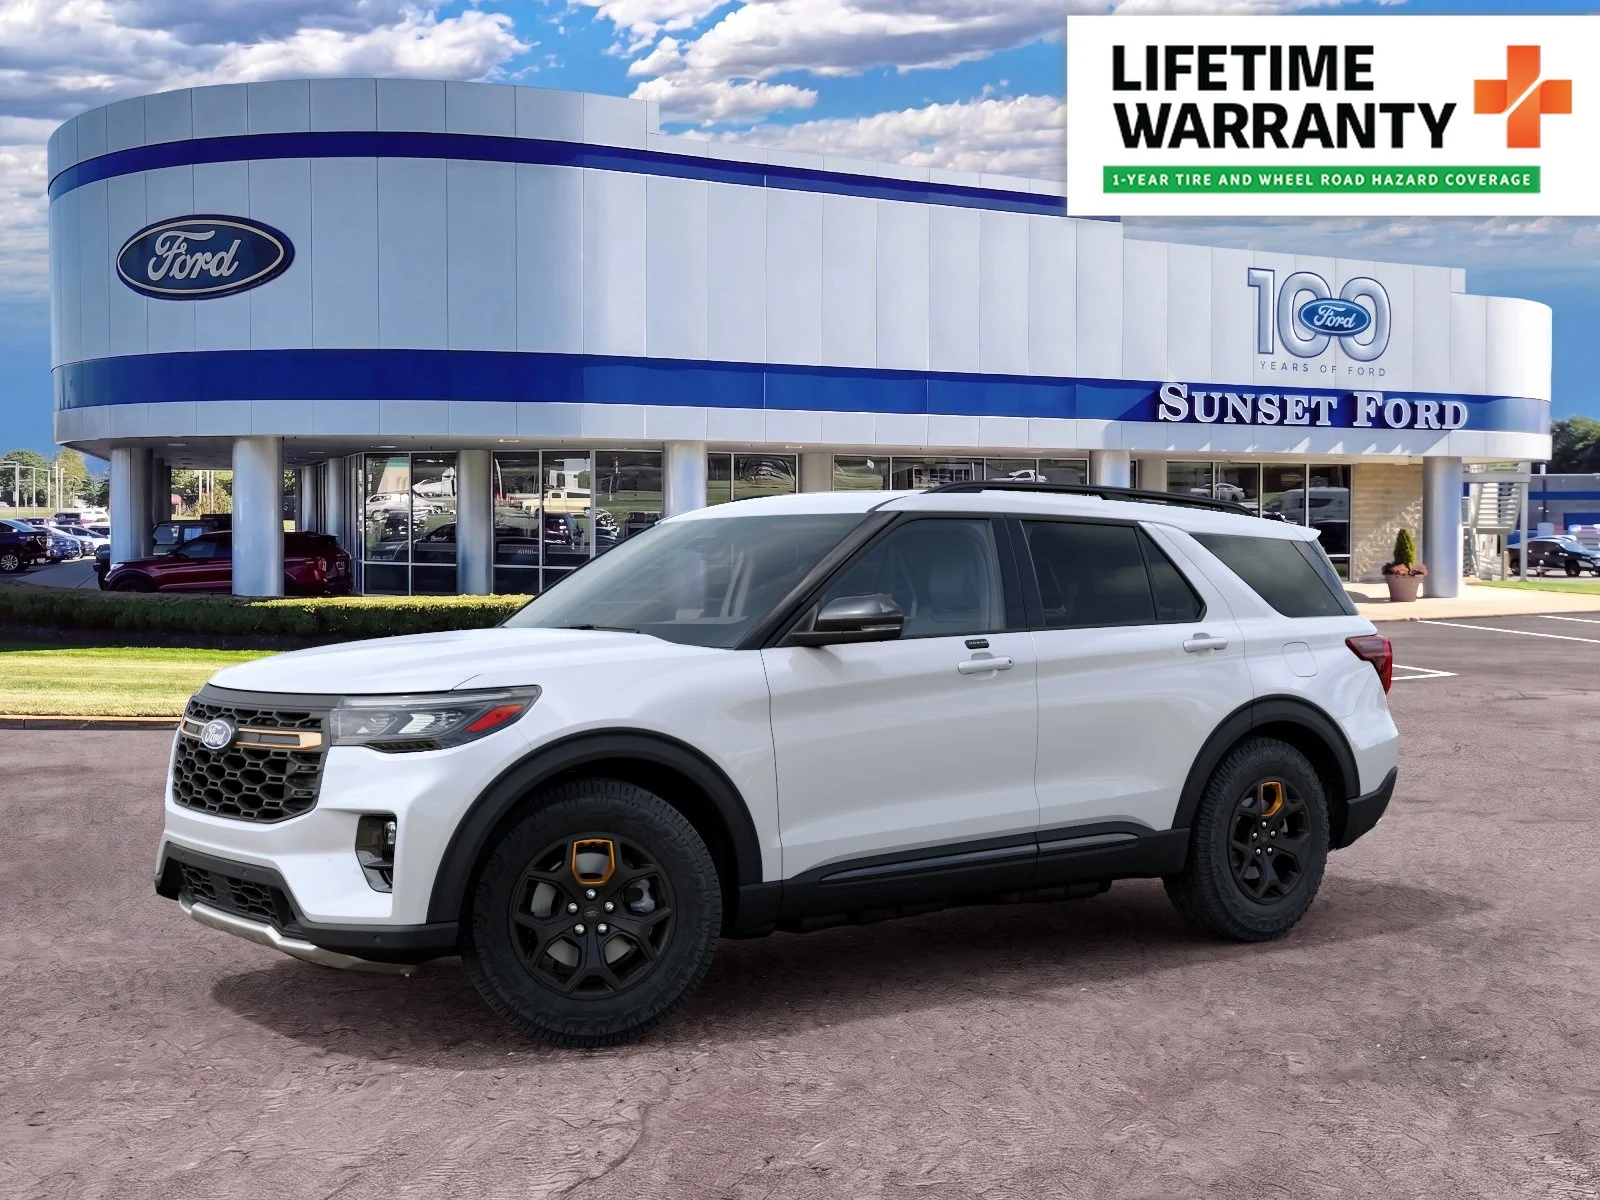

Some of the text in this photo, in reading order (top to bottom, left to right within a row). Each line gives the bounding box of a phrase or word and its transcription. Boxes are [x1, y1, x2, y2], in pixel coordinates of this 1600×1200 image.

[148, 230, 241, 281] Ford
[1247, 267, 1391, 362] 100
[1313, 305, 1356, 329] Ford
[1260, 360, 1386, 377] YEARS OF FORD
[1158, 382, 1468, 431] SUNSET FORD
[205, 723, 226, 745] Ford
